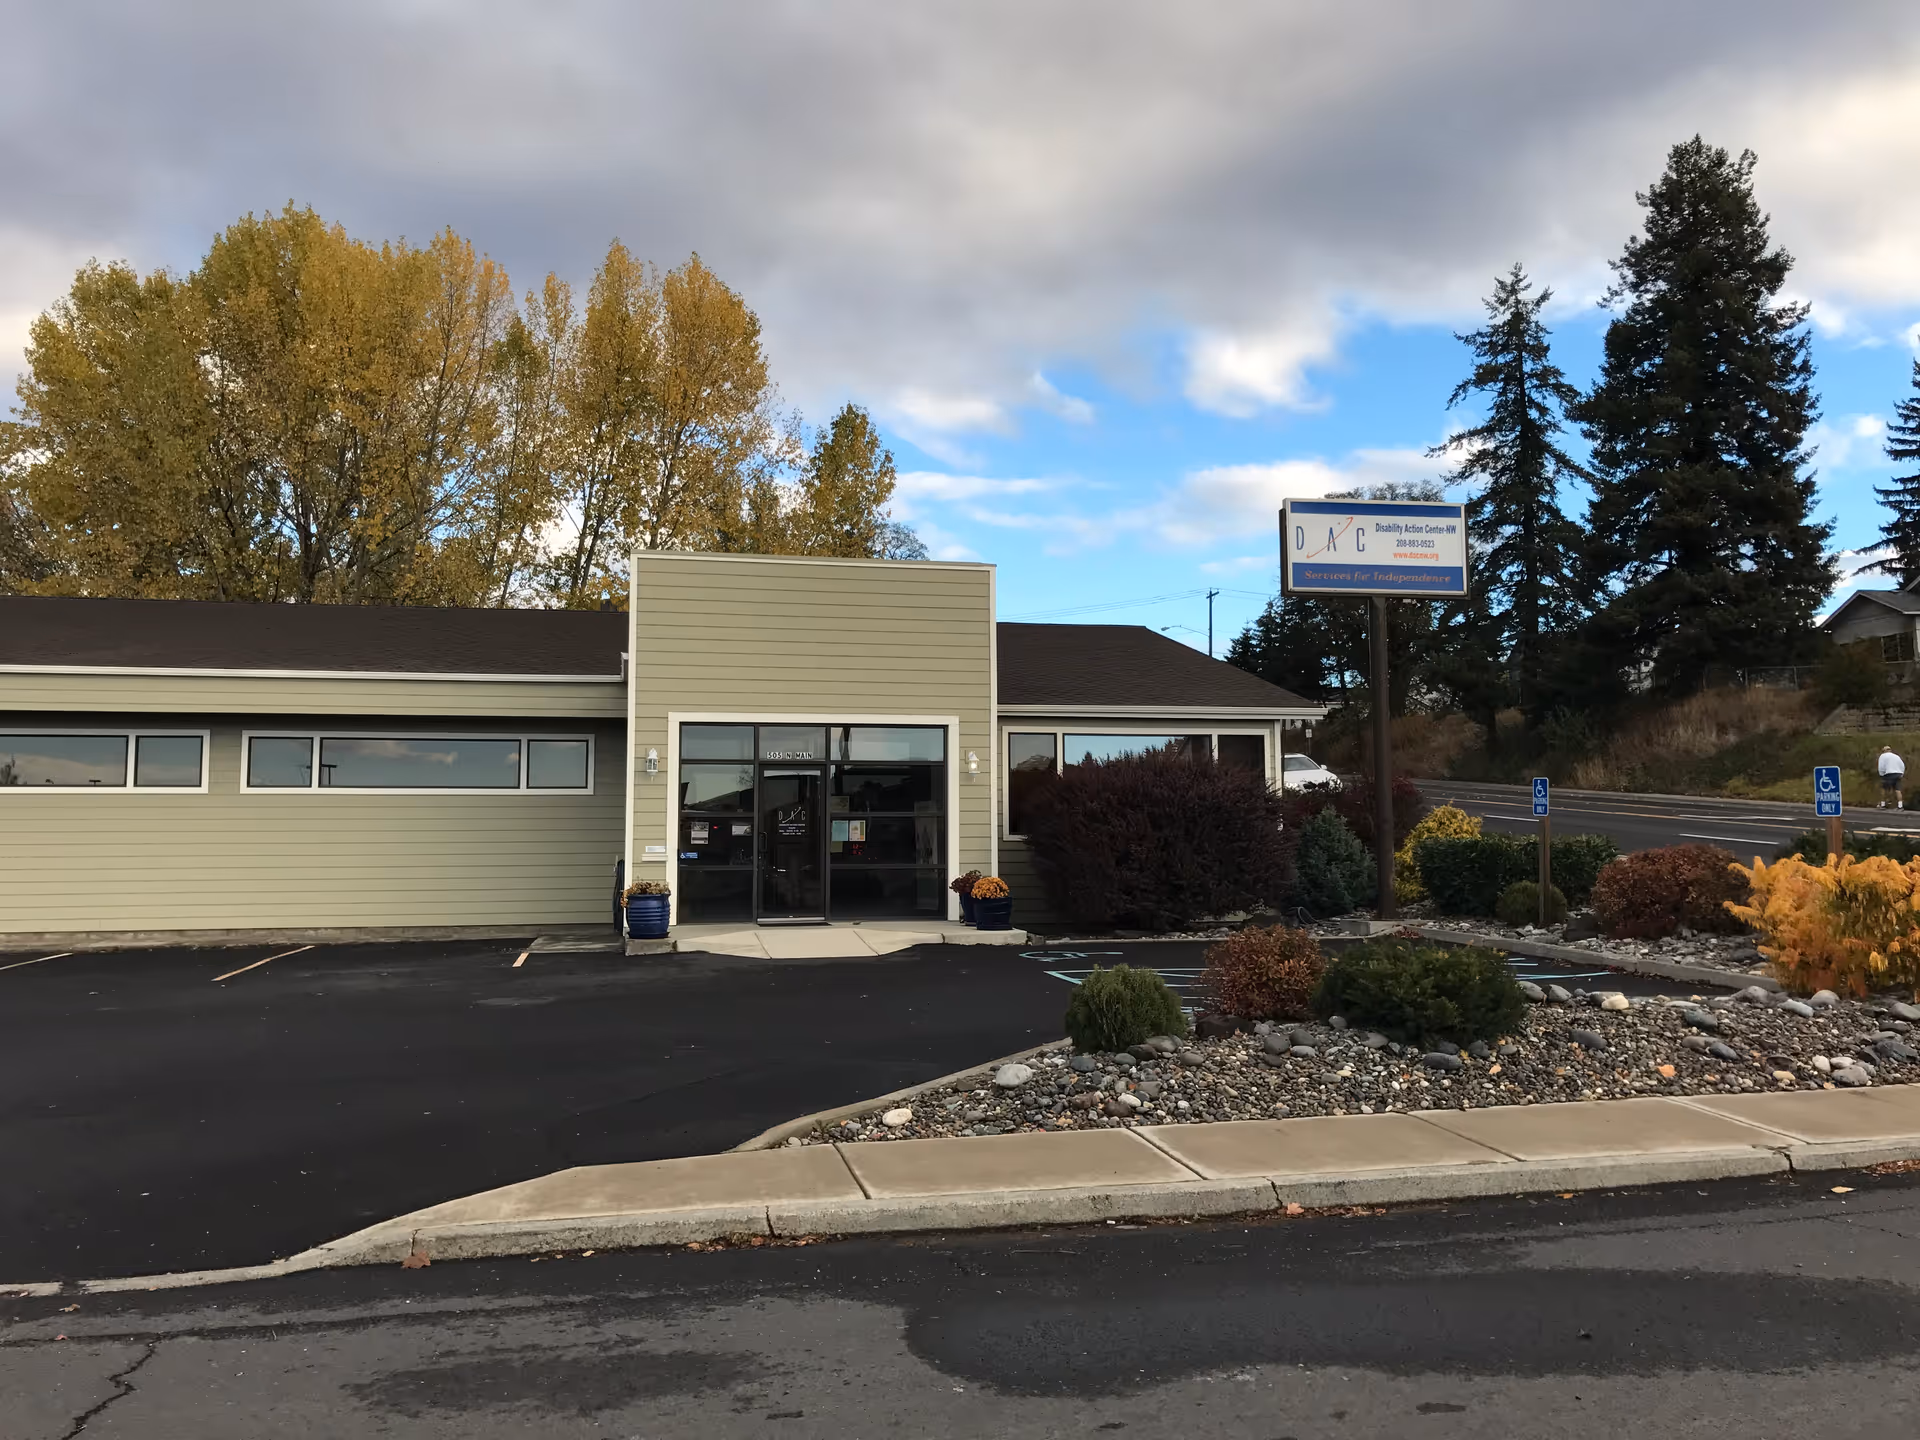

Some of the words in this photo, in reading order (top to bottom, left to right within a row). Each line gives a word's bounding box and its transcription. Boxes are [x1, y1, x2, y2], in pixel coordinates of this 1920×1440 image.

[1375, 522, 1403, 535] Disability
[1404, 523, 1424, 534] Action
[1424, 524, 1457, 535] Center-NW
[1296, 525, 1305, 550] D
[1327, 527, 1337, 552] A
[1356, 527, 1365, 552] C
[1396, 539, 1435, 549] 208-883-0523
[1304, 570, 1351, 581] Services
[1373, 571, 1451, 584] Independence
[766, 751, 783, 760] 505
[785, 751, 793, 760] N
[795, 751, 814, 760] MAIN
[1816, 792, 1840, 802] PARKING
[1822, 803, 1836, 813] ONLY
